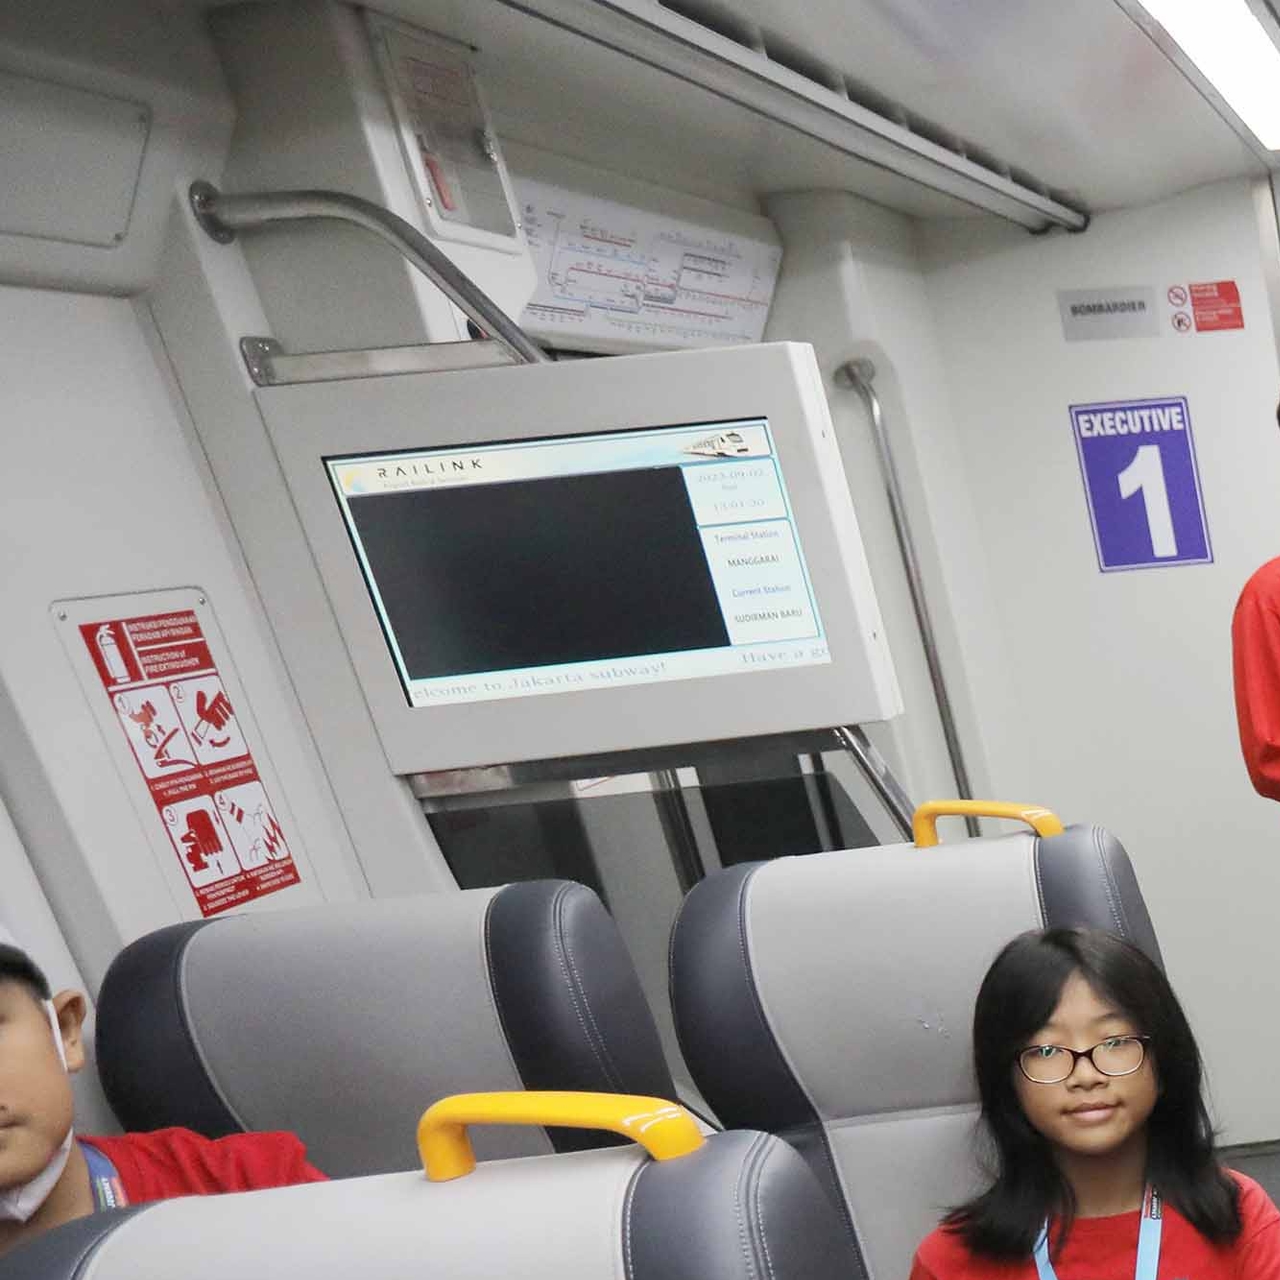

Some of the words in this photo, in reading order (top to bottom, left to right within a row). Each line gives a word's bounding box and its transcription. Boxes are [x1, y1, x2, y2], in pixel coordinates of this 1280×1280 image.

[1070, 300, 1146, 317] BOMBARDIER
[1078, 407, 1184, 437] EXECUTIVE
[377, 458, 484, 478] RAILINK
[1117, 444, 1178, 558] 1
[714, 532, 750, 545] Terminal
[752, 529, 780, 541] Station
[727, 555, 779, 568] MANGGARAI
[732, 587, 762, 599] Current
[763, 584, 791, 596] Station
[734, 611, 780, 624] SUDIRMAN
[780, 608, 803, 619] BARU
[740, 649, 788, 665] Have
[483, 679, 503, 693] to
[506, 671, 583, 691] Jakarta
[589, 660, 668, 682] subway!
